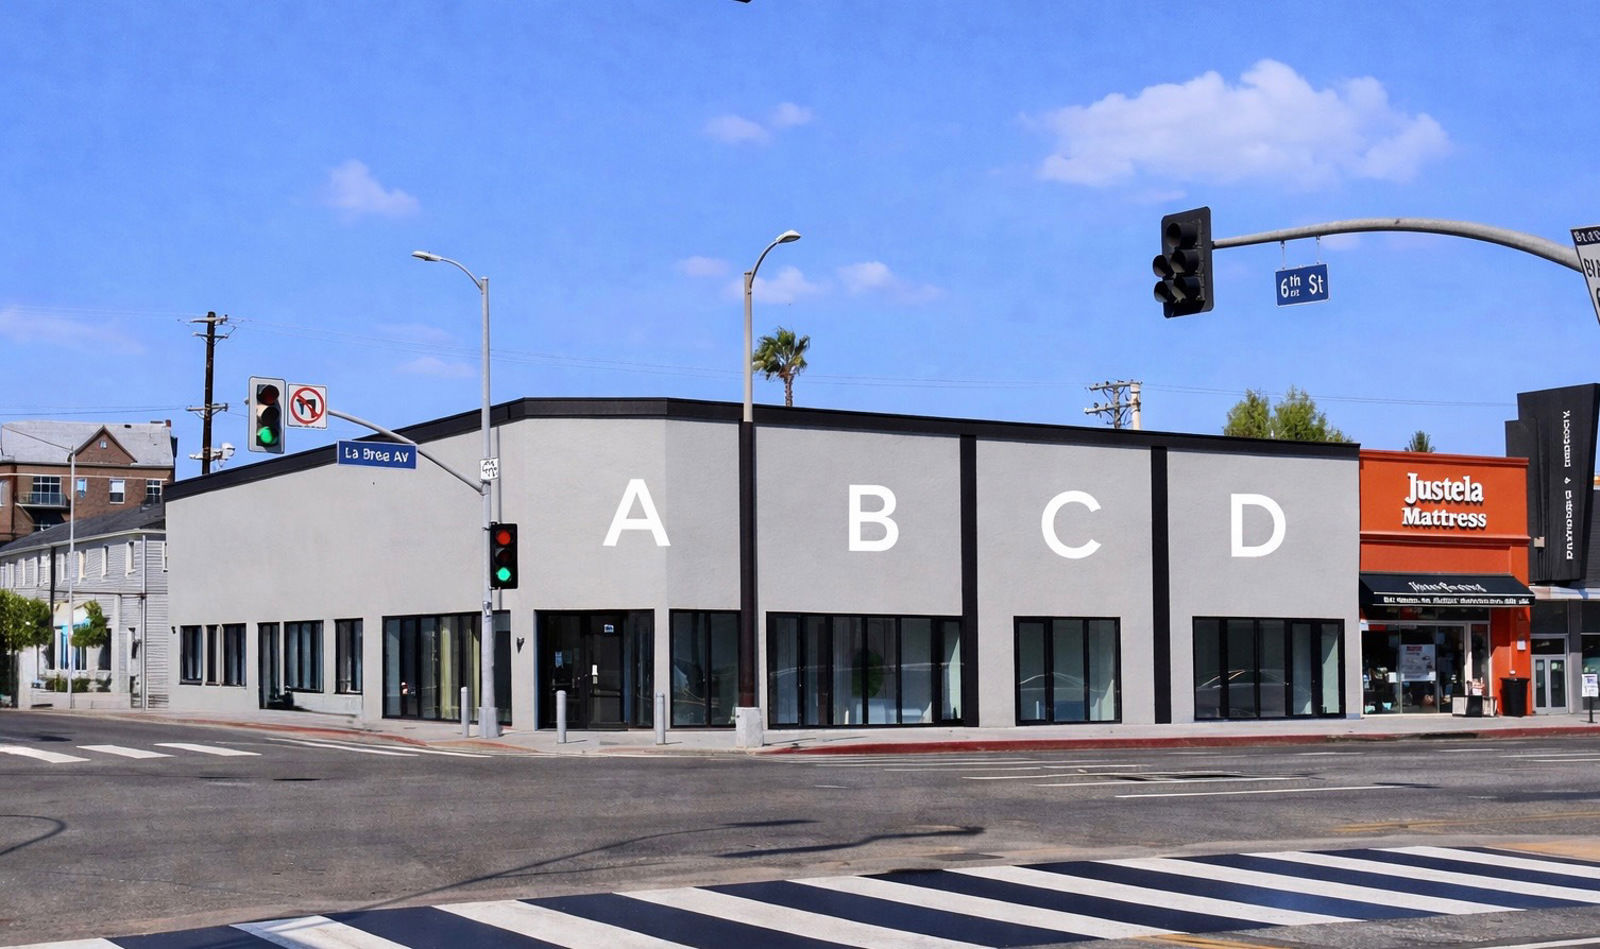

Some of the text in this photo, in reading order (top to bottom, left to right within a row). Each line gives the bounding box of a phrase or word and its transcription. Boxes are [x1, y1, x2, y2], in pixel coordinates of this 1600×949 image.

[1280, 274, 1324, 298] 6th St
[345, 447, 359, 459] La
[1404, 472, 1484, 504] Justela
[1401, 507, 1487, 527] Mattress
